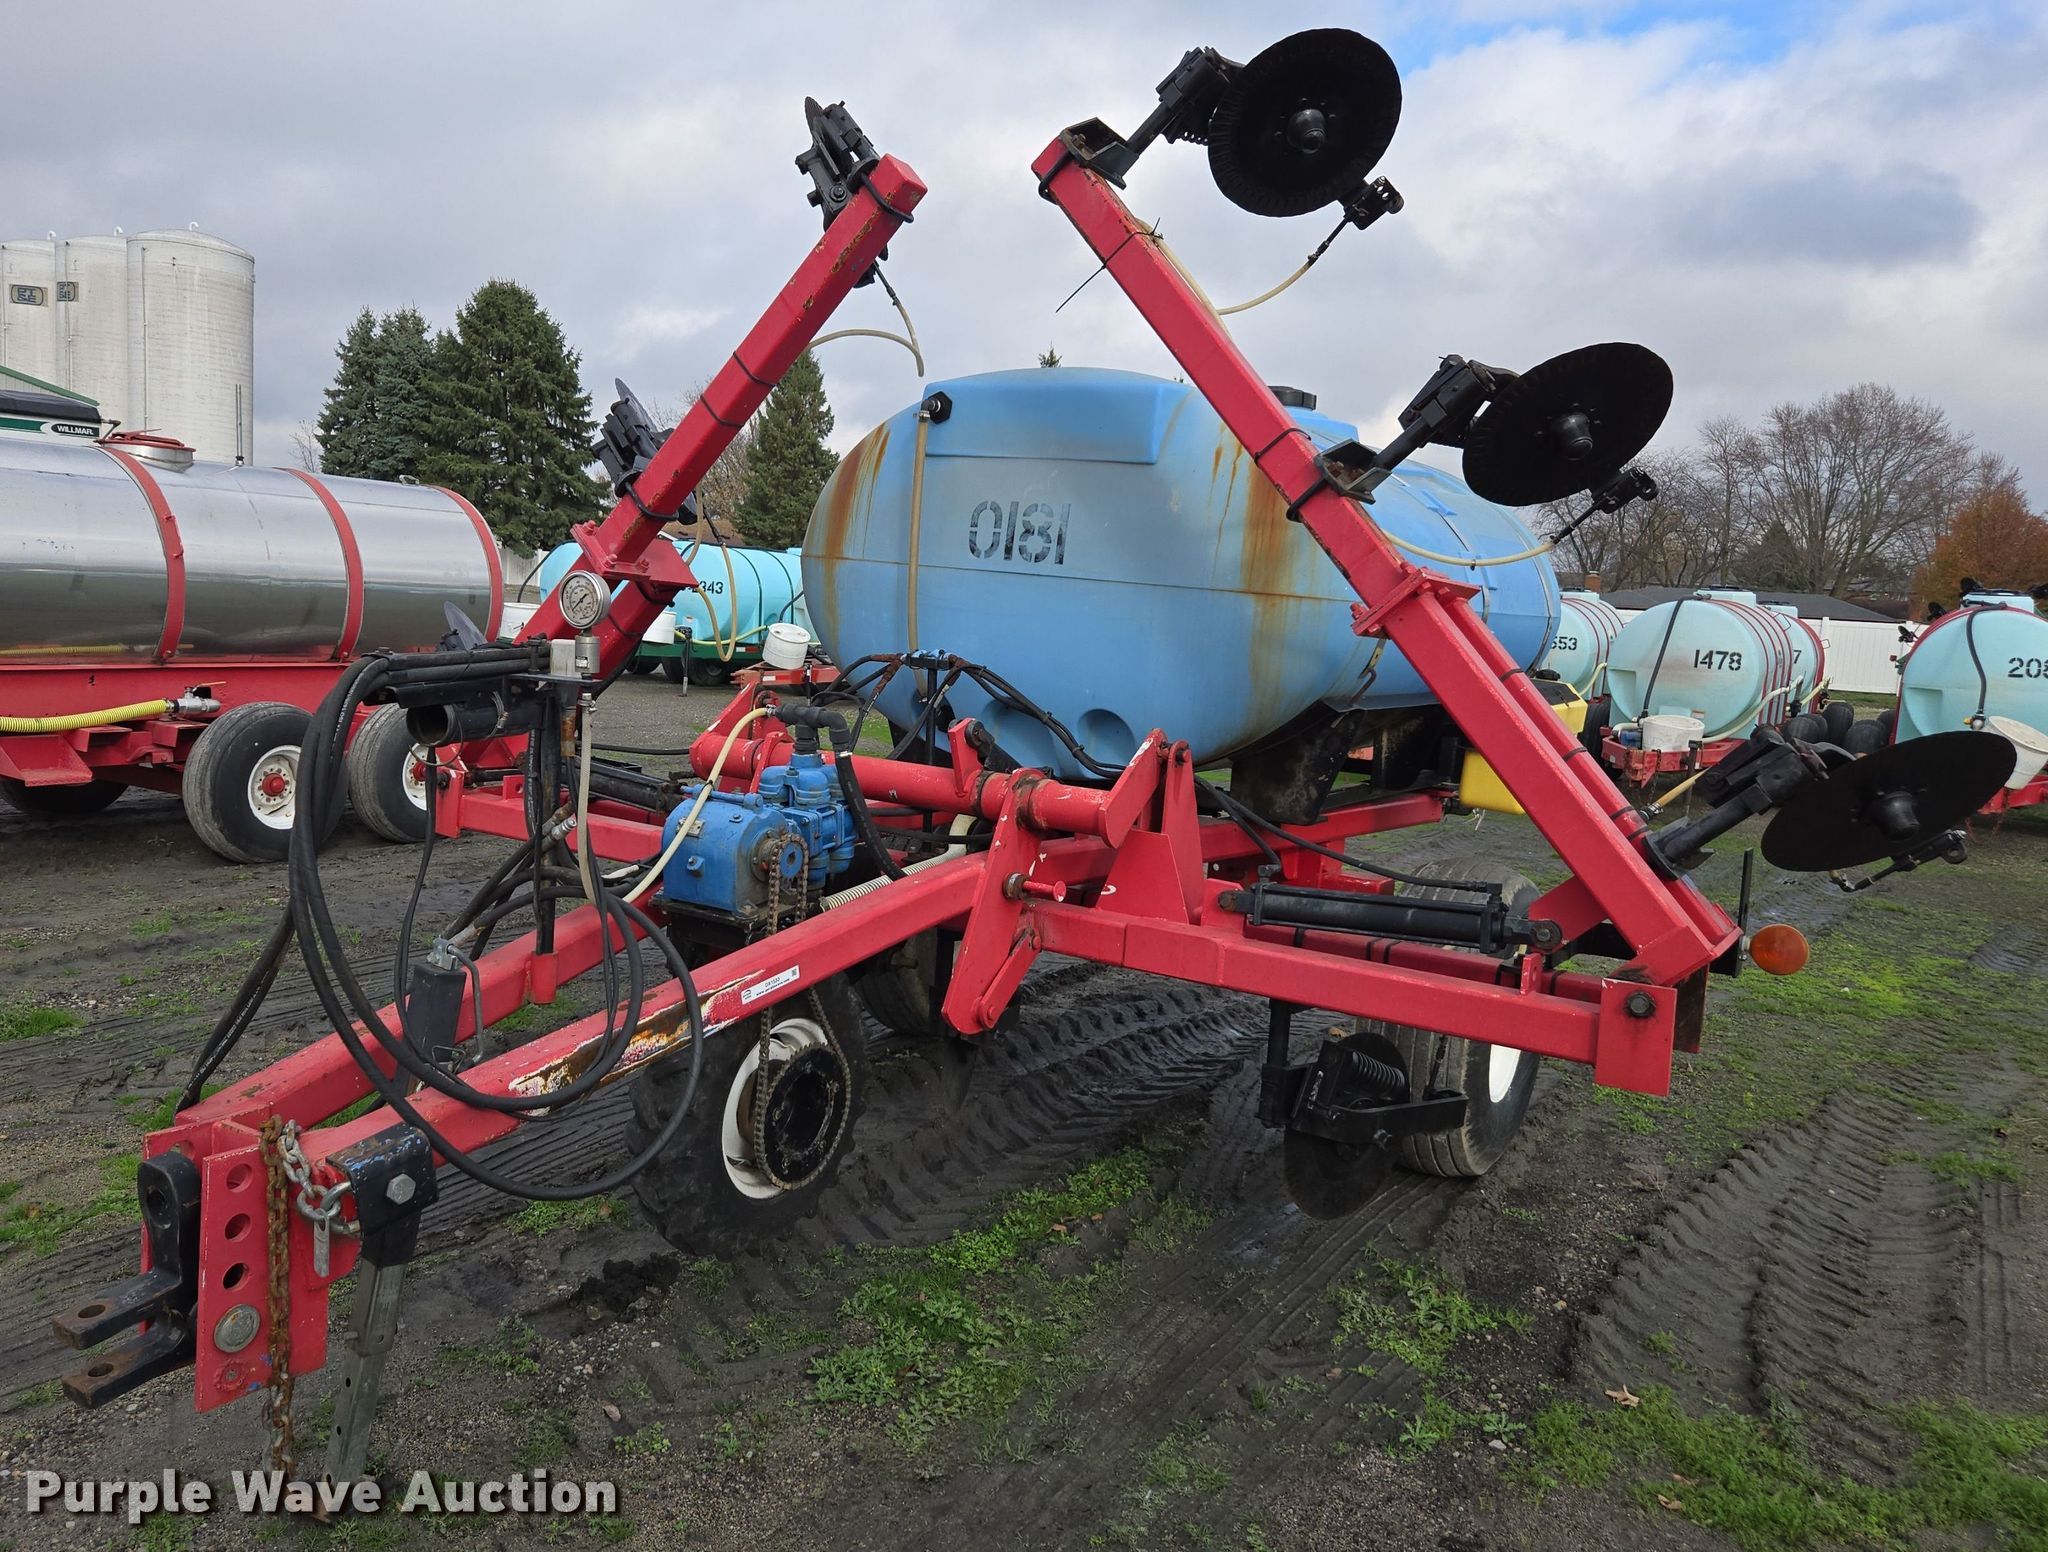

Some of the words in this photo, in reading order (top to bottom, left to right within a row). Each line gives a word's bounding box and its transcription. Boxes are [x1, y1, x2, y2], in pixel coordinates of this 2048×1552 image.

[57, 424, 95, 435] WILLMAR
[968, 500, 1071, 565] 0181
[692, 580, 724, 594] 343
[1694, 649, 1742, 671] 1478
